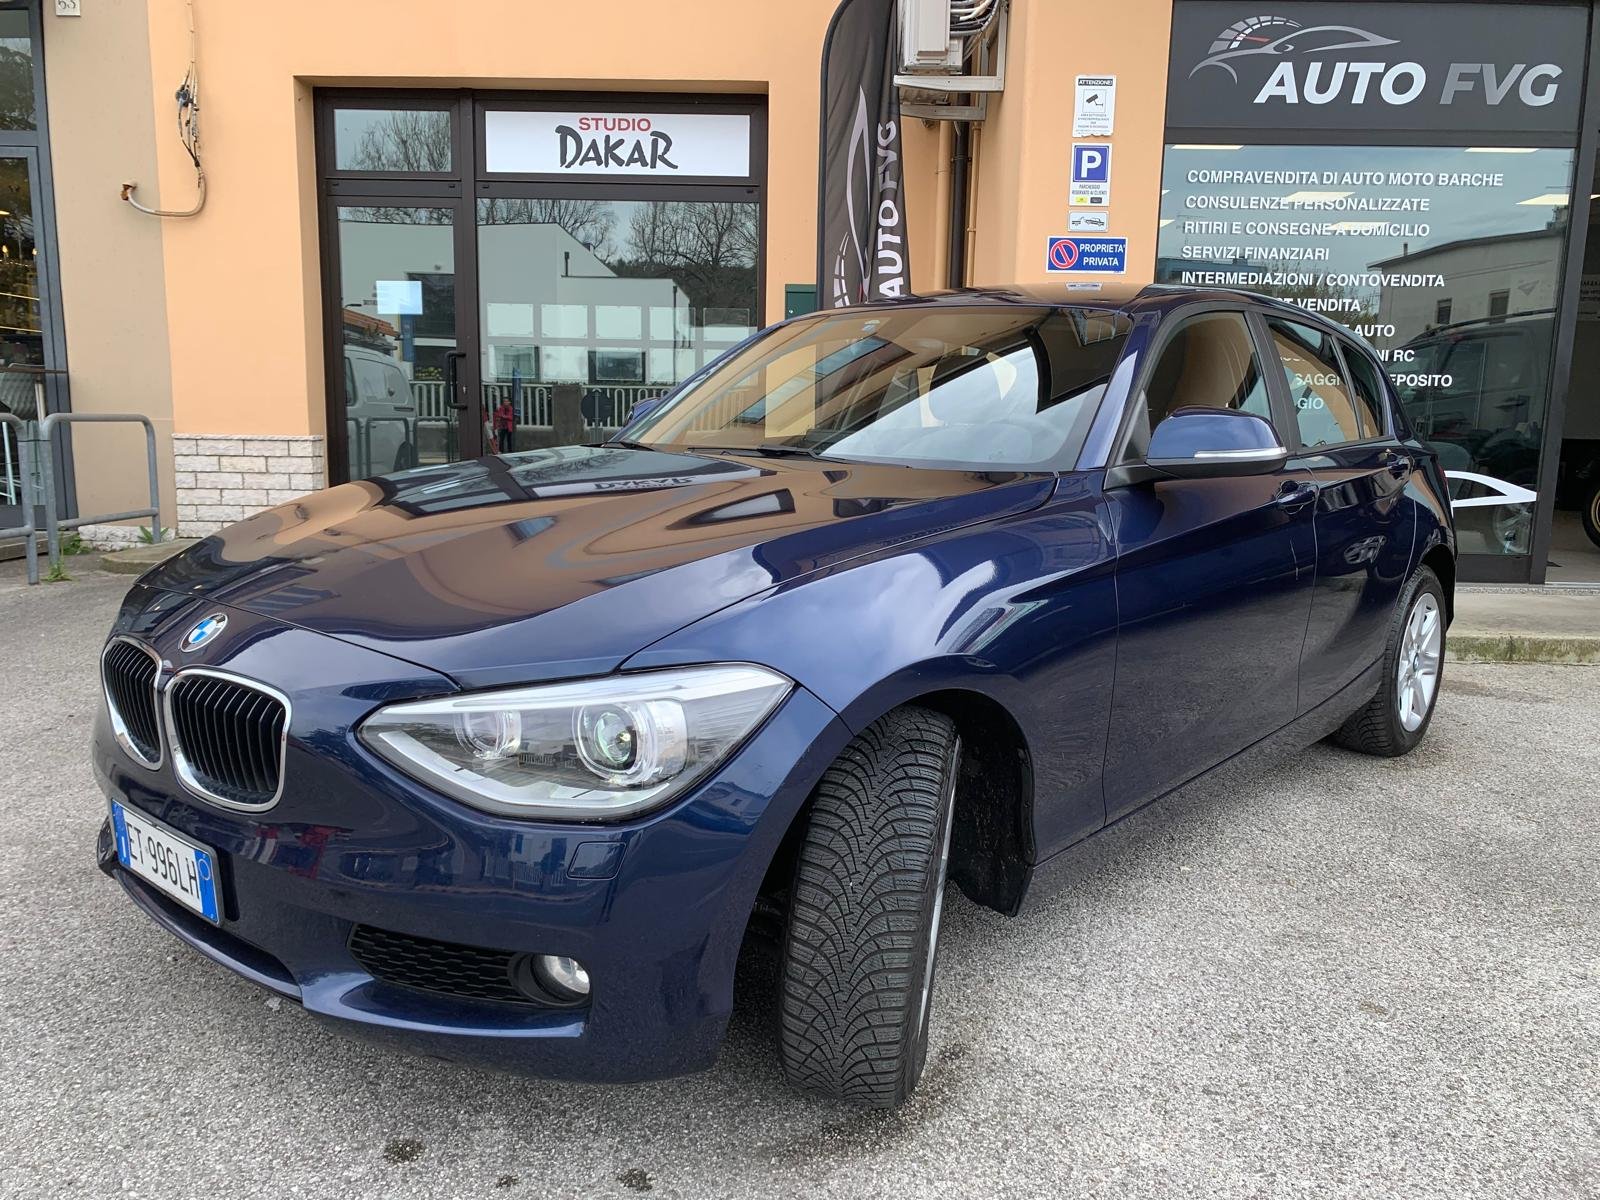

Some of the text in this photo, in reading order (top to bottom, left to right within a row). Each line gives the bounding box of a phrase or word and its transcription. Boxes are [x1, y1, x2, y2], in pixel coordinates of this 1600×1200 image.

[1253, 62, 1563, 107] AUTO FVG
[578, 117, 651, 131] STUDIO
[555, 124, 679, 169] DAKAR
[1080, 150, 1102, 178] P
[1187, 170, 1504, 186] COMPRAVENDITA DI AUTO MOTO BARCHE
[877, 120, 904, 298] AUTO FVG
[1185, 195, 1430, 211] CONSULENZE PERSONALIZZATE
[1184, 221, 1430, 237] RITIRI E CONSEGNE A DOMICILIO
[1182, 245, 1330, 260] SERVIZI FINANZIARI
[1083, 257, 1119, 266] PRIVATA
[1181, 271, 1445, 287] INTERMEDIAZIONI / CONTOVENDITA
[1297, 298, 1361, 312] VENDITA
[1353, 324, 1396, 337] AUTO
[1393, 349, 1415, 362] RC
[126, 822, 200, 899] ET 996LH
